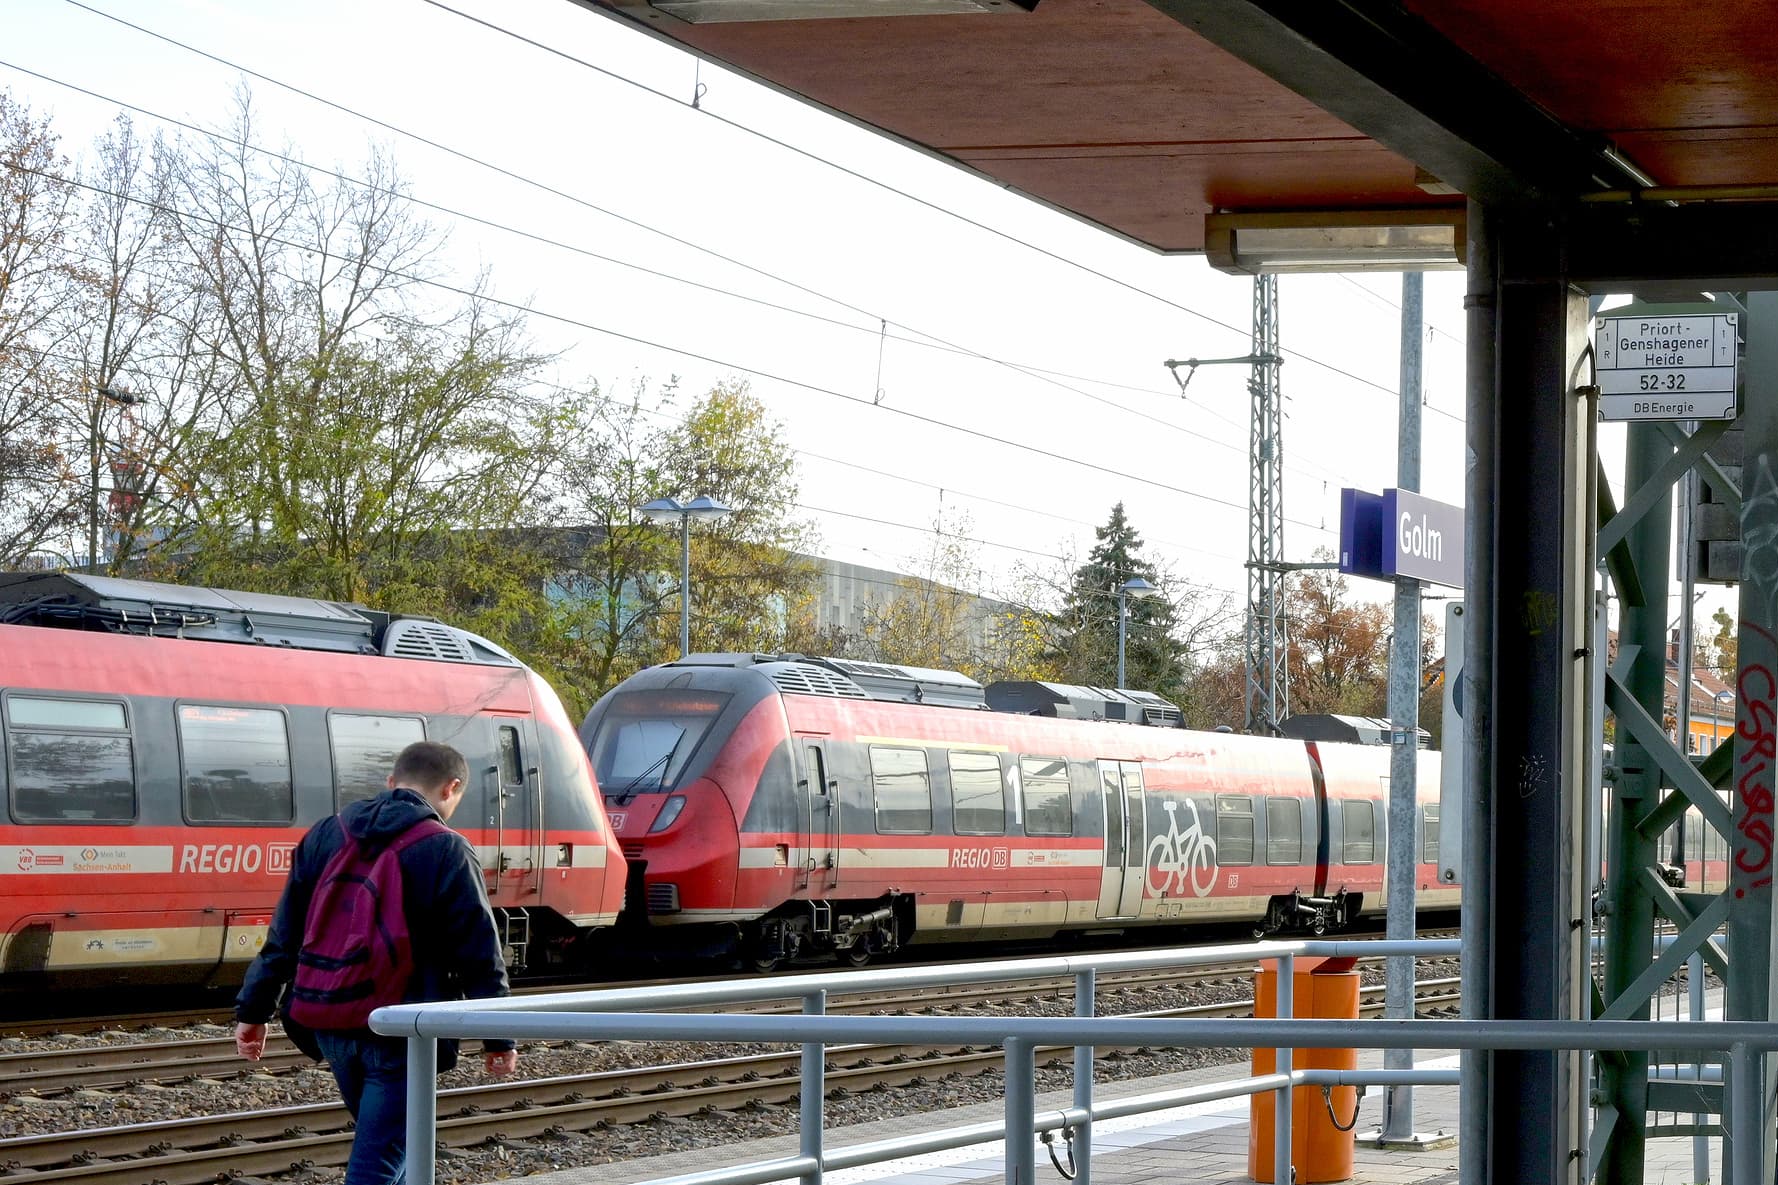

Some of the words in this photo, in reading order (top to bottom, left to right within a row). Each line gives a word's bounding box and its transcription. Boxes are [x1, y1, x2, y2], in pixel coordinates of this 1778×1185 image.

[1620, 337, 1709, 351] Genshagener
[1604, 350, 1610, 359] R
[1645, 353, 1684, 366] Heide
[1640, 373, 1685, 390] 52-32
[1400, 511, 1442, 562] Golm
[1006, 765, 1022, 824] 1
[489, 815, 495, 825] 2
[179, 844, 262, 873] REGIO
[951, 848, 990, 868] REGIO
[993, 849, 1007, 867] DB
